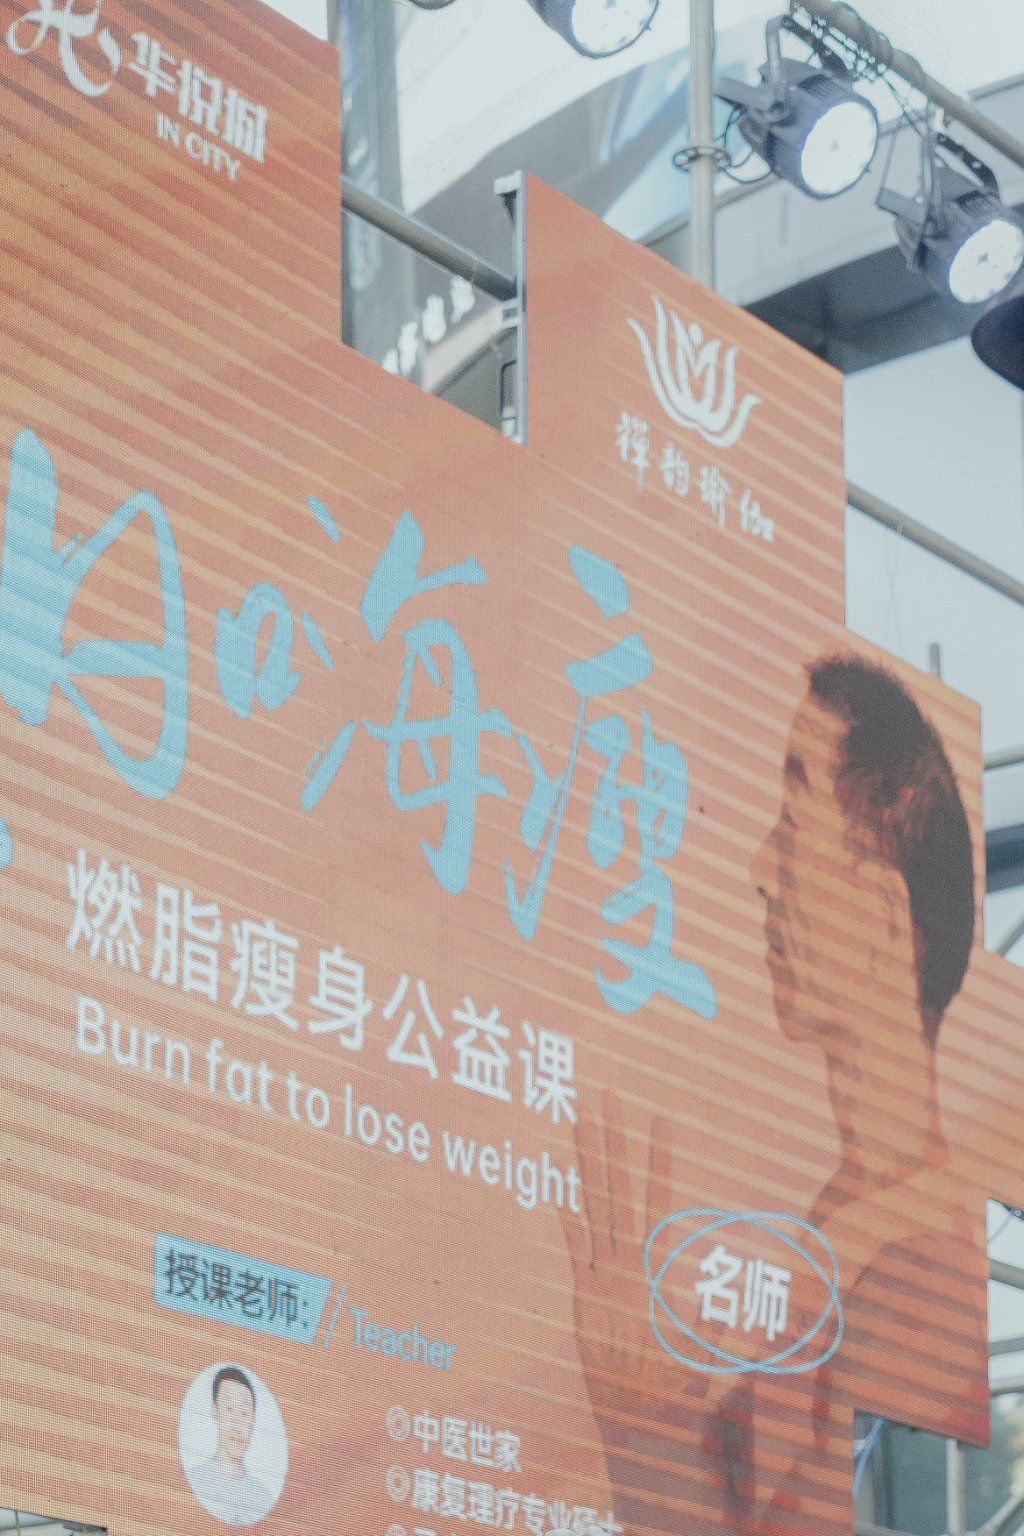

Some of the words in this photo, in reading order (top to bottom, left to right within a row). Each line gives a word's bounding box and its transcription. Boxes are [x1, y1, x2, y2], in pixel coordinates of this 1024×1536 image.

[155, 112, 181, 149] IN
[184, 131, 242, 181] CITY
[66, 847, 578, 1124] 燃脂瘦身公益课
[74, 996, 191, 1084] Burn
[207, 1039, 273, 1113] fat
[287, 1075, 331, 1129] to
[343, 1083, 431, 1161] lose
[443, 1128, 581, 1214] weight
[694, 1242, 793, 1342] 名师
[348, 1305, 458, 1373] Teacher
[411, 1408, 521, 1473] 中医世家
